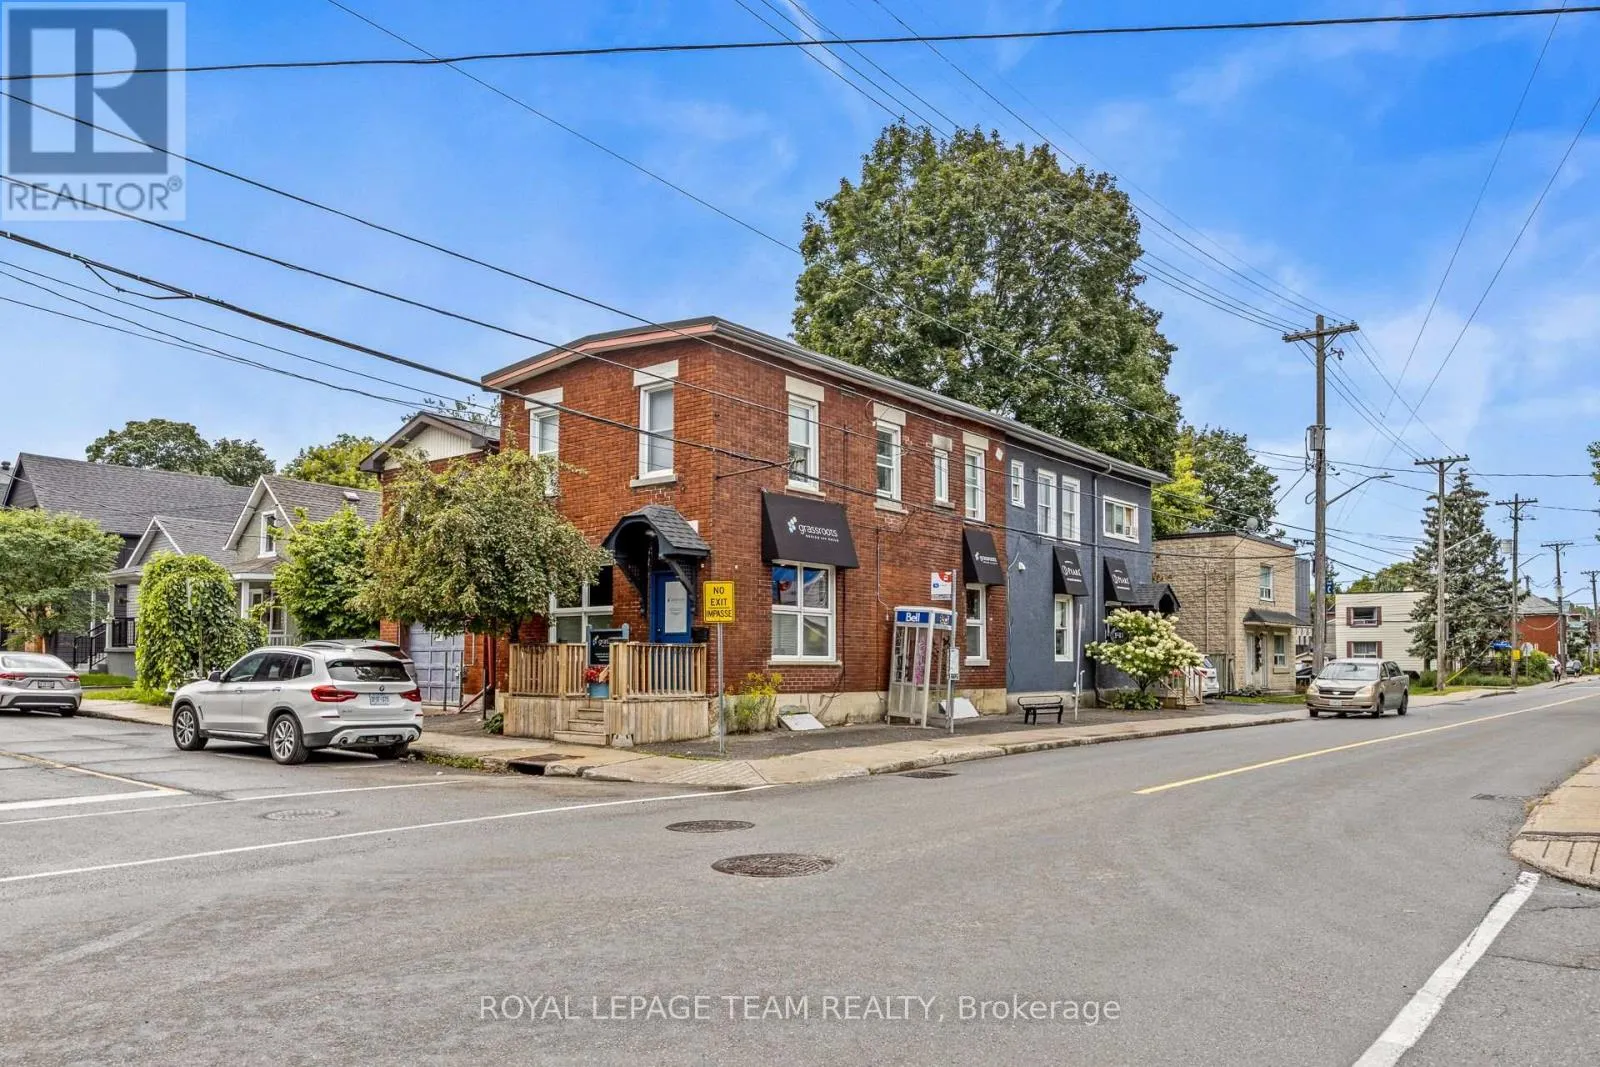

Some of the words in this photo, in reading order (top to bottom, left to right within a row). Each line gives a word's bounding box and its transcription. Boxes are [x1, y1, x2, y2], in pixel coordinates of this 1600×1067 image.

[798, 524, 838, 537] grassroots
[713, 586, 725, 595] NO
[710, 598, 728, 607] EXIT
[706, 609, 732, 618] IMPASSE
[905, 612, 920, 622] Bell
